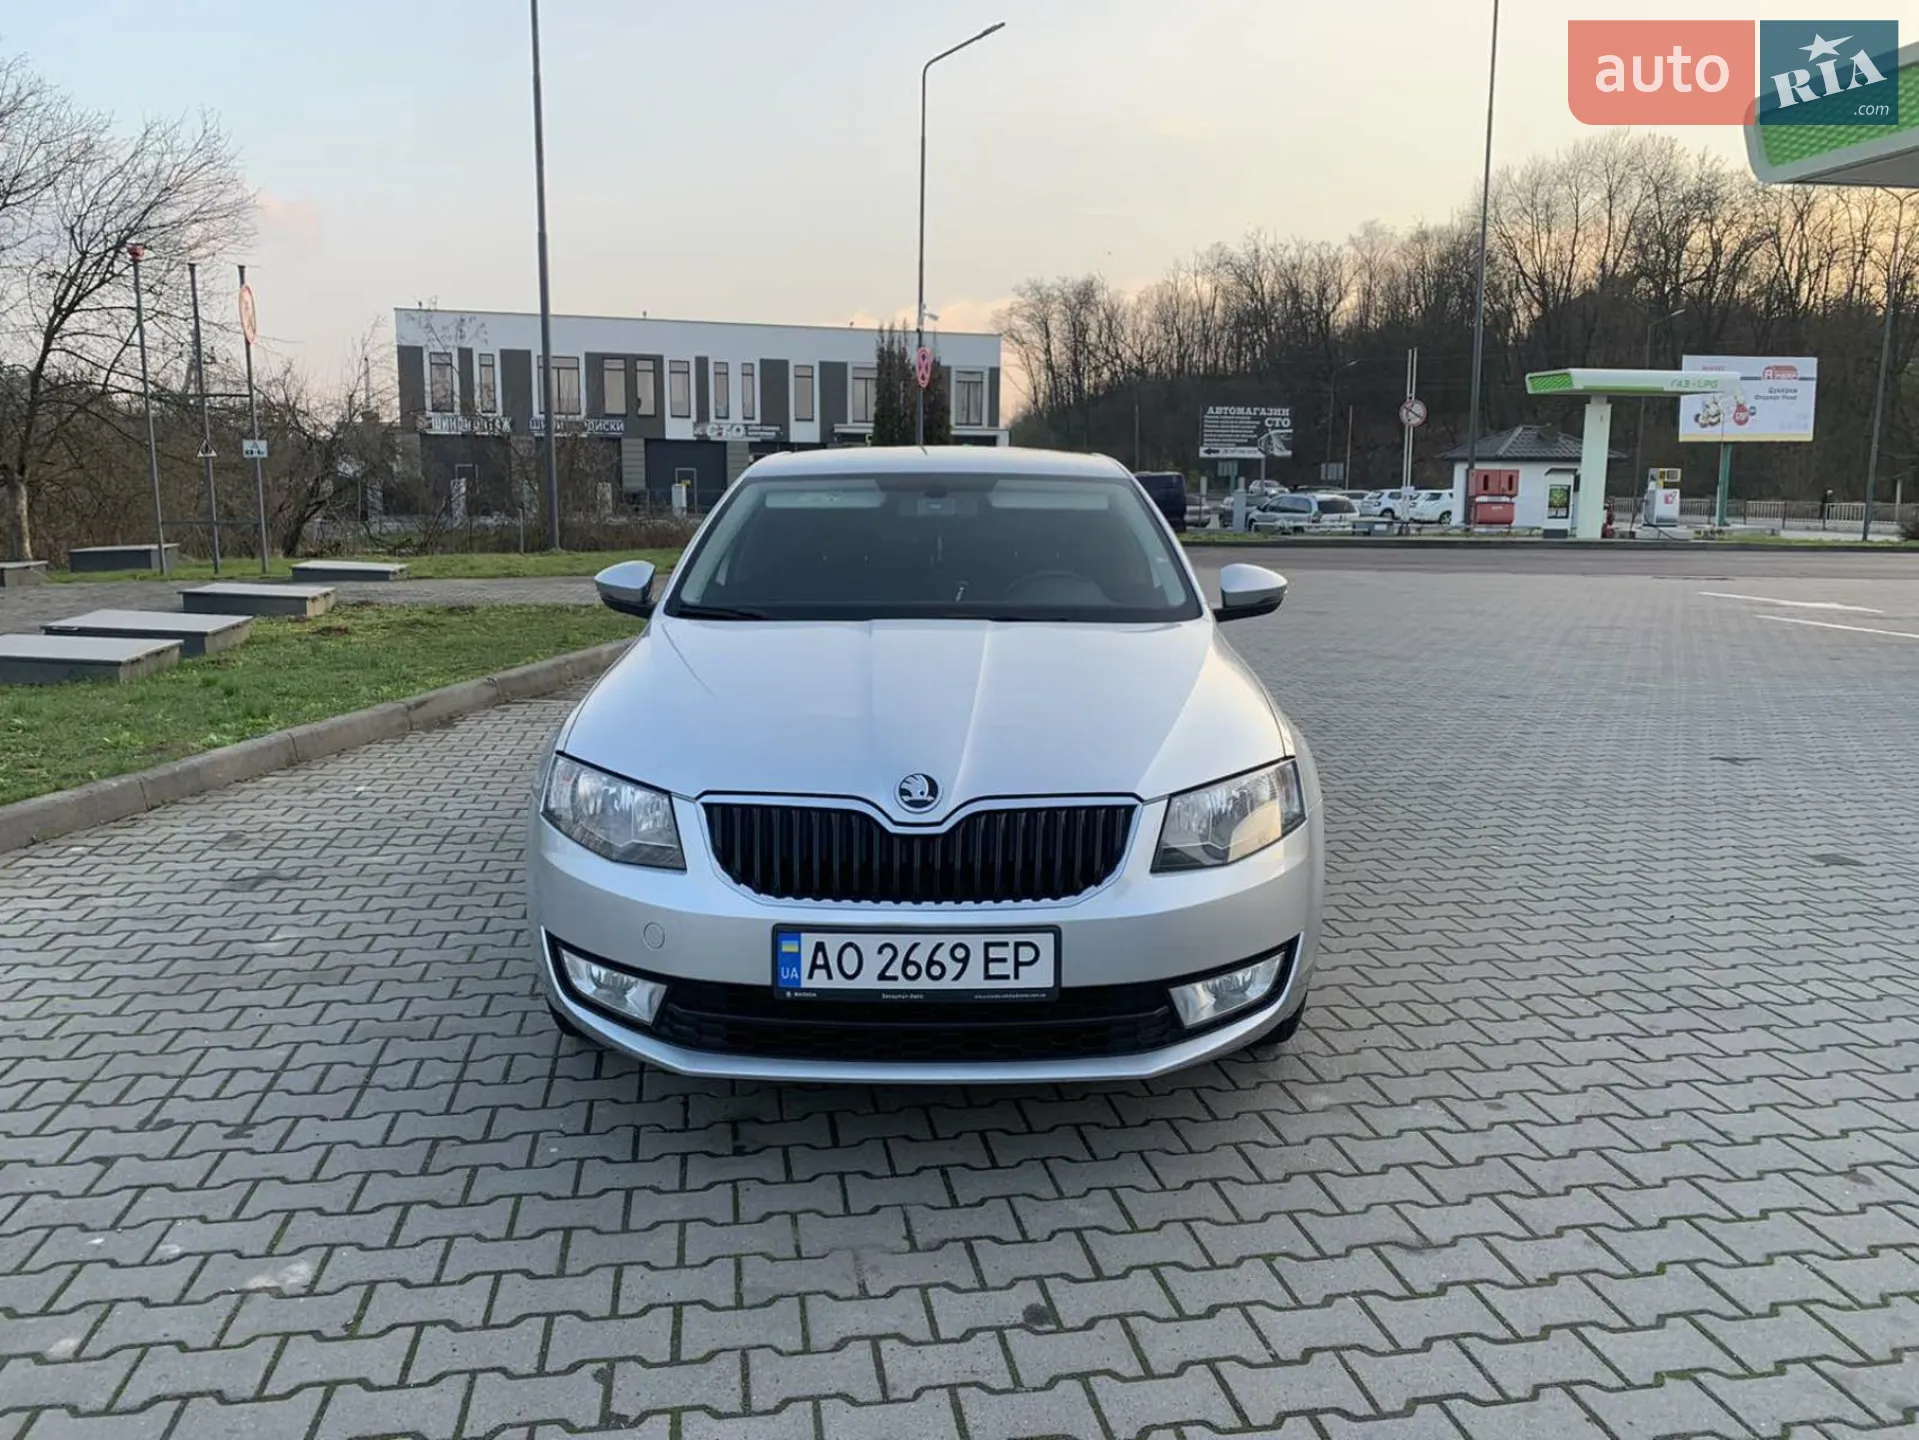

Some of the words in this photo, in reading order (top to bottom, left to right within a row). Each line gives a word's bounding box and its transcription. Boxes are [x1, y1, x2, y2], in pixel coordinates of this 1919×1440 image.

[1206, 406, 1291, 416] АВТОМАГАЗИН
[587, 419, 625, 432] ДИСКИ
[1264, 417, 1291, 428] СТО
[706, 423, 746, 438] СТО
[781, 966, 799, 980] UA
[807, 940, 864, 981] AO
[876, 941, 972, 982] 2669
[983, 941, 1041, 981] EP
